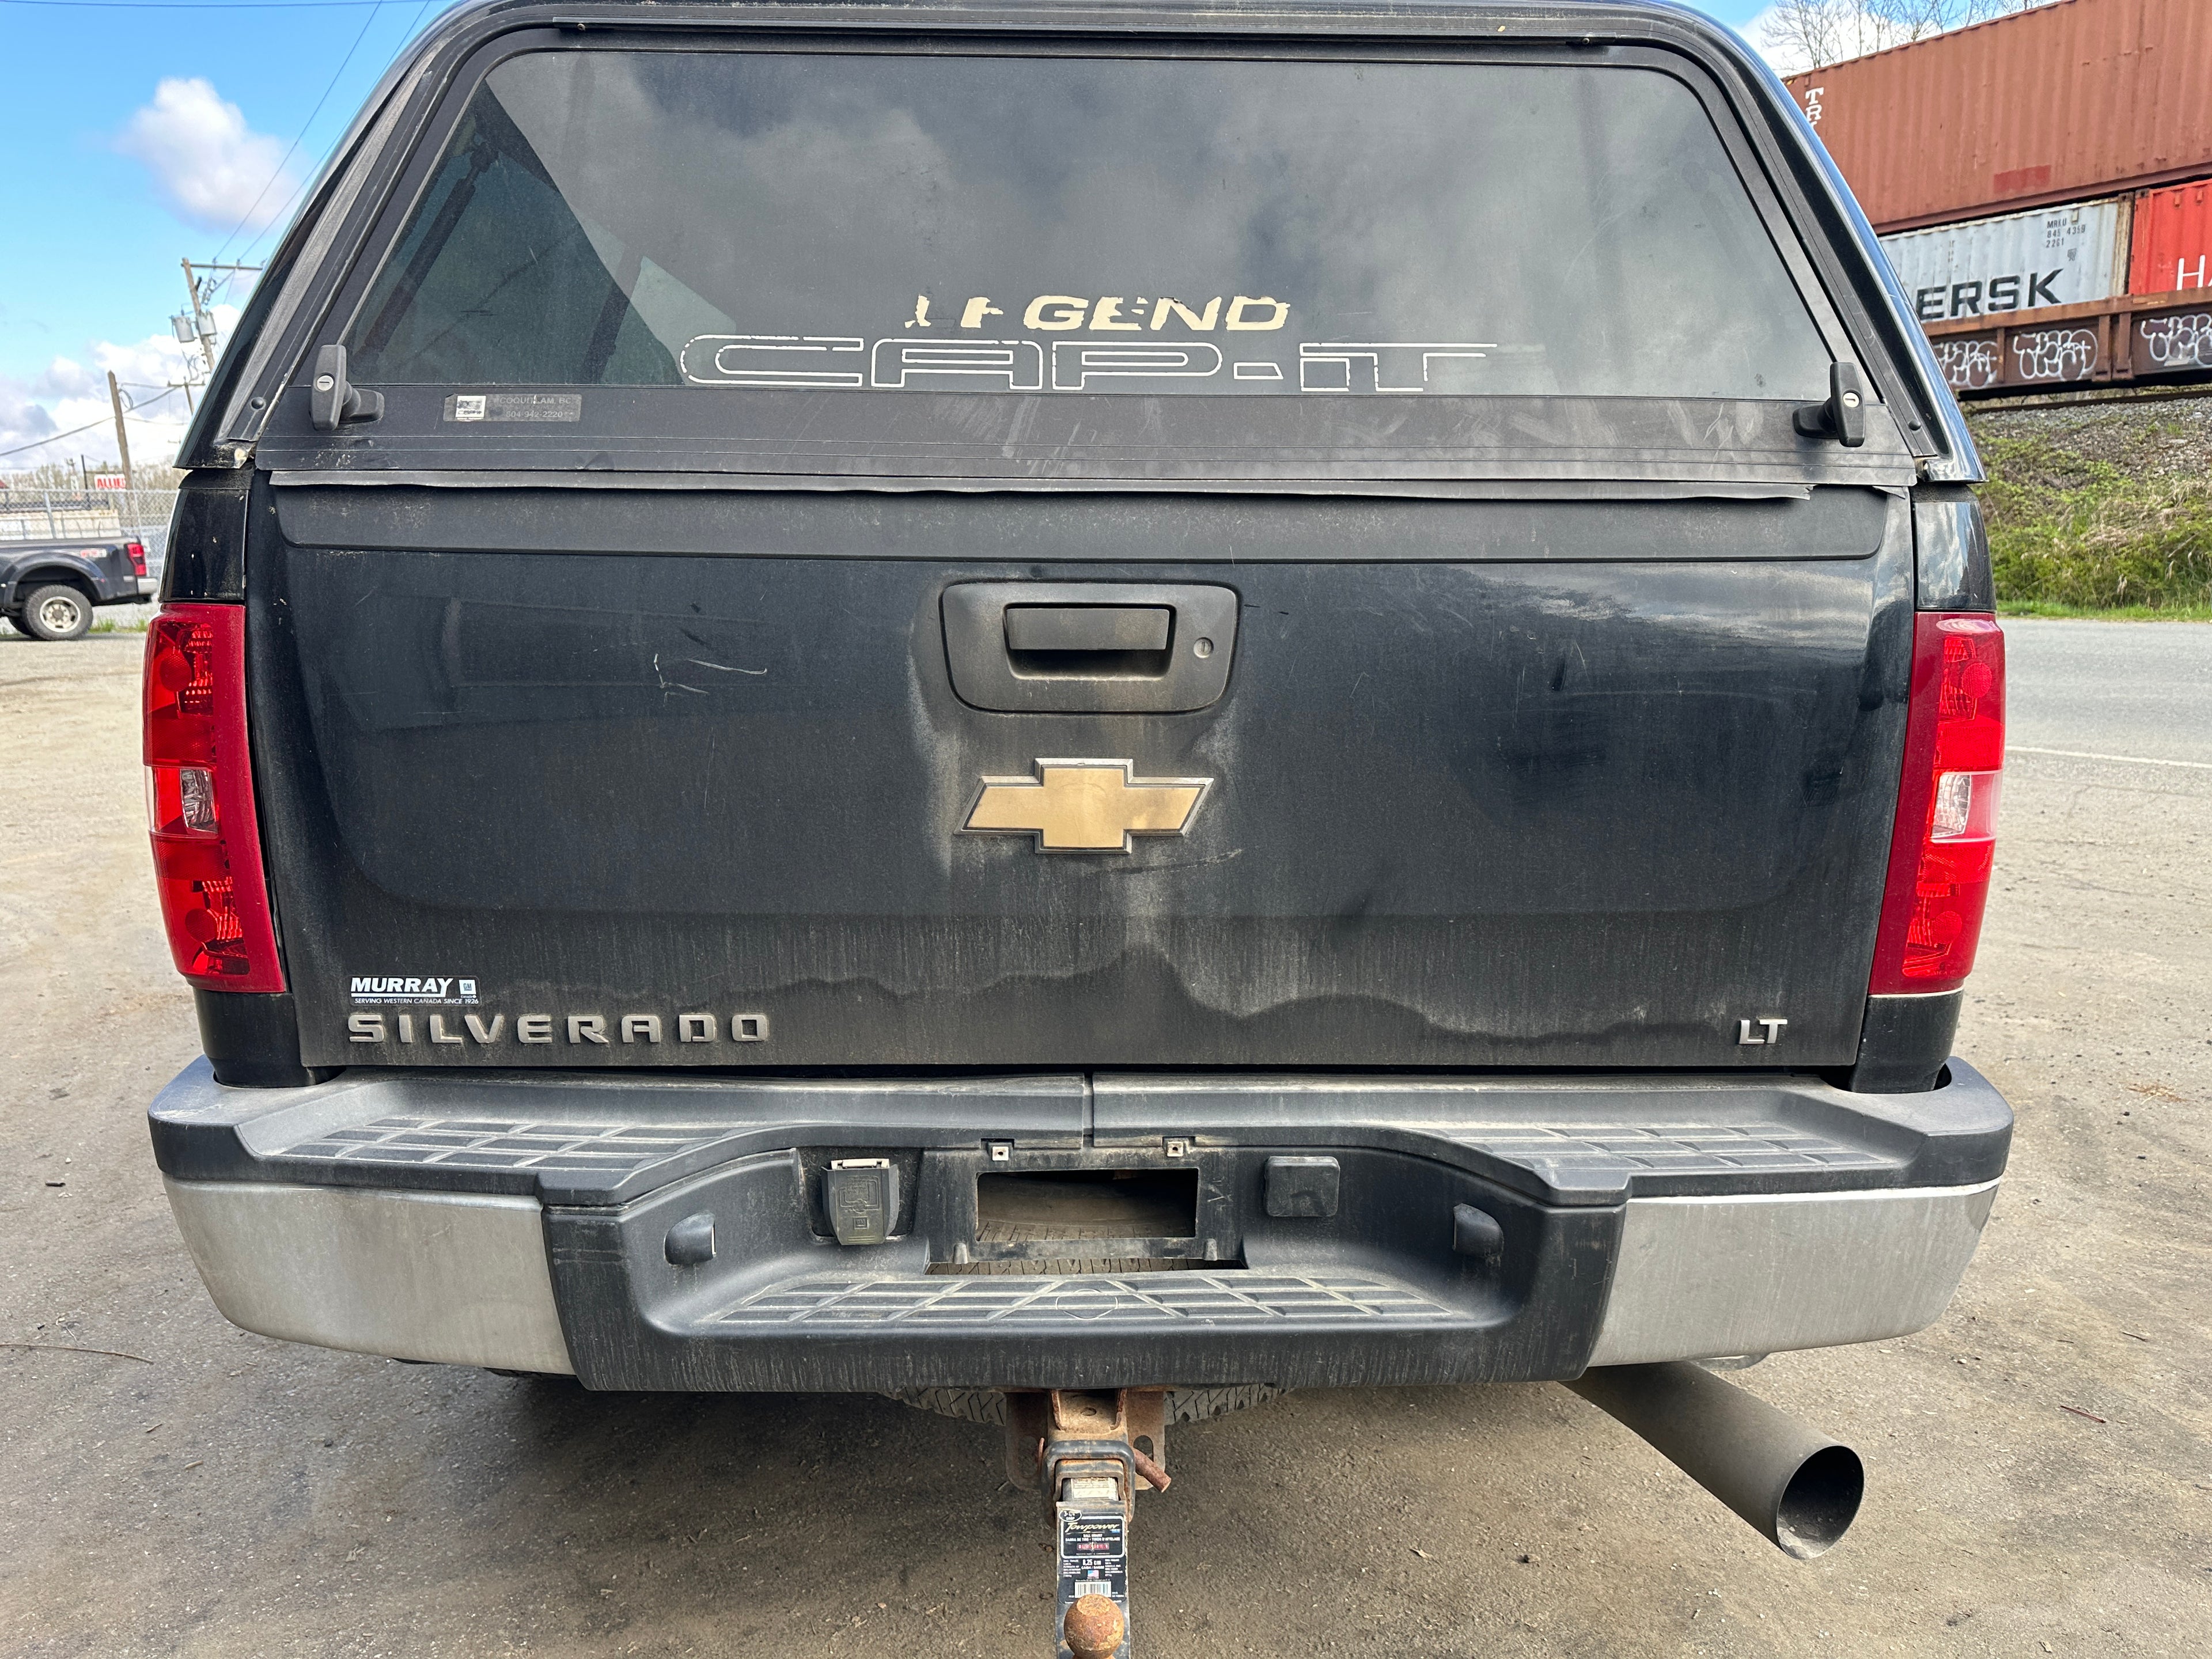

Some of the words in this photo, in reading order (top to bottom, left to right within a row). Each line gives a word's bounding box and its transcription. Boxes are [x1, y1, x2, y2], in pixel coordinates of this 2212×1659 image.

[2047, 218, 2066, 229] MRKU
[2047, 228, 2061, 238] 845
[2177, 255, 2212, 290] H
[1916, 268, 2063, 320] ERSK
[350, 978, 453, 997] MURRAY
[347, 1014, 770, 1044] SILVERADO
[1738, 1018, 1788, 1044] LT
[1065, 1522, 1120, 1533] Towpower
